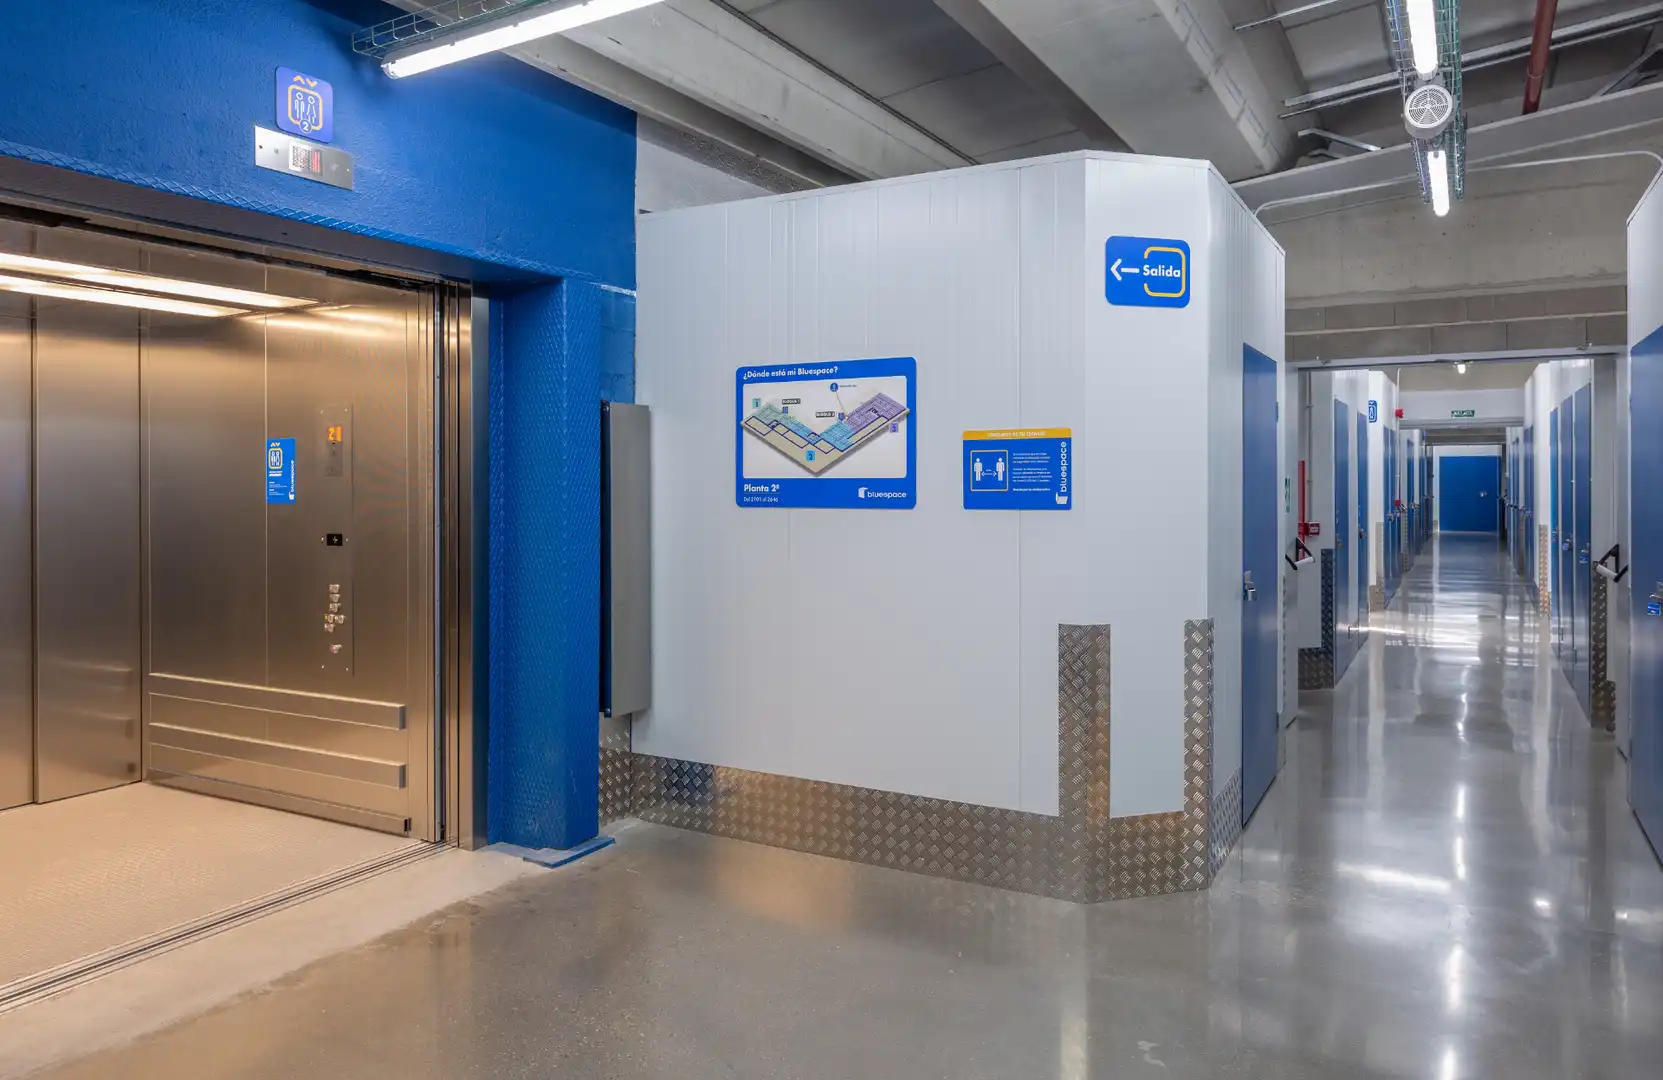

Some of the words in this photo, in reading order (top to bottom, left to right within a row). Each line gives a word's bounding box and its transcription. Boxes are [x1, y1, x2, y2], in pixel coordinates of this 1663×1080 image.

[302, 121, 309, 131] 2
[1143, 264, 1181, 278] Salida
[743, 370, 769, 380] ¿Dónde
[771, 368, 786, 377] está
[787, 368, 796, 376] mi
[798, 366, 839, 376] Bluespace?
[891, 425, 897, 433] 3
[1060, 441, 1068, 493] bluespace
[743, 483, 769, 492] Planta
[867, 491, 907, 499] bluespace
